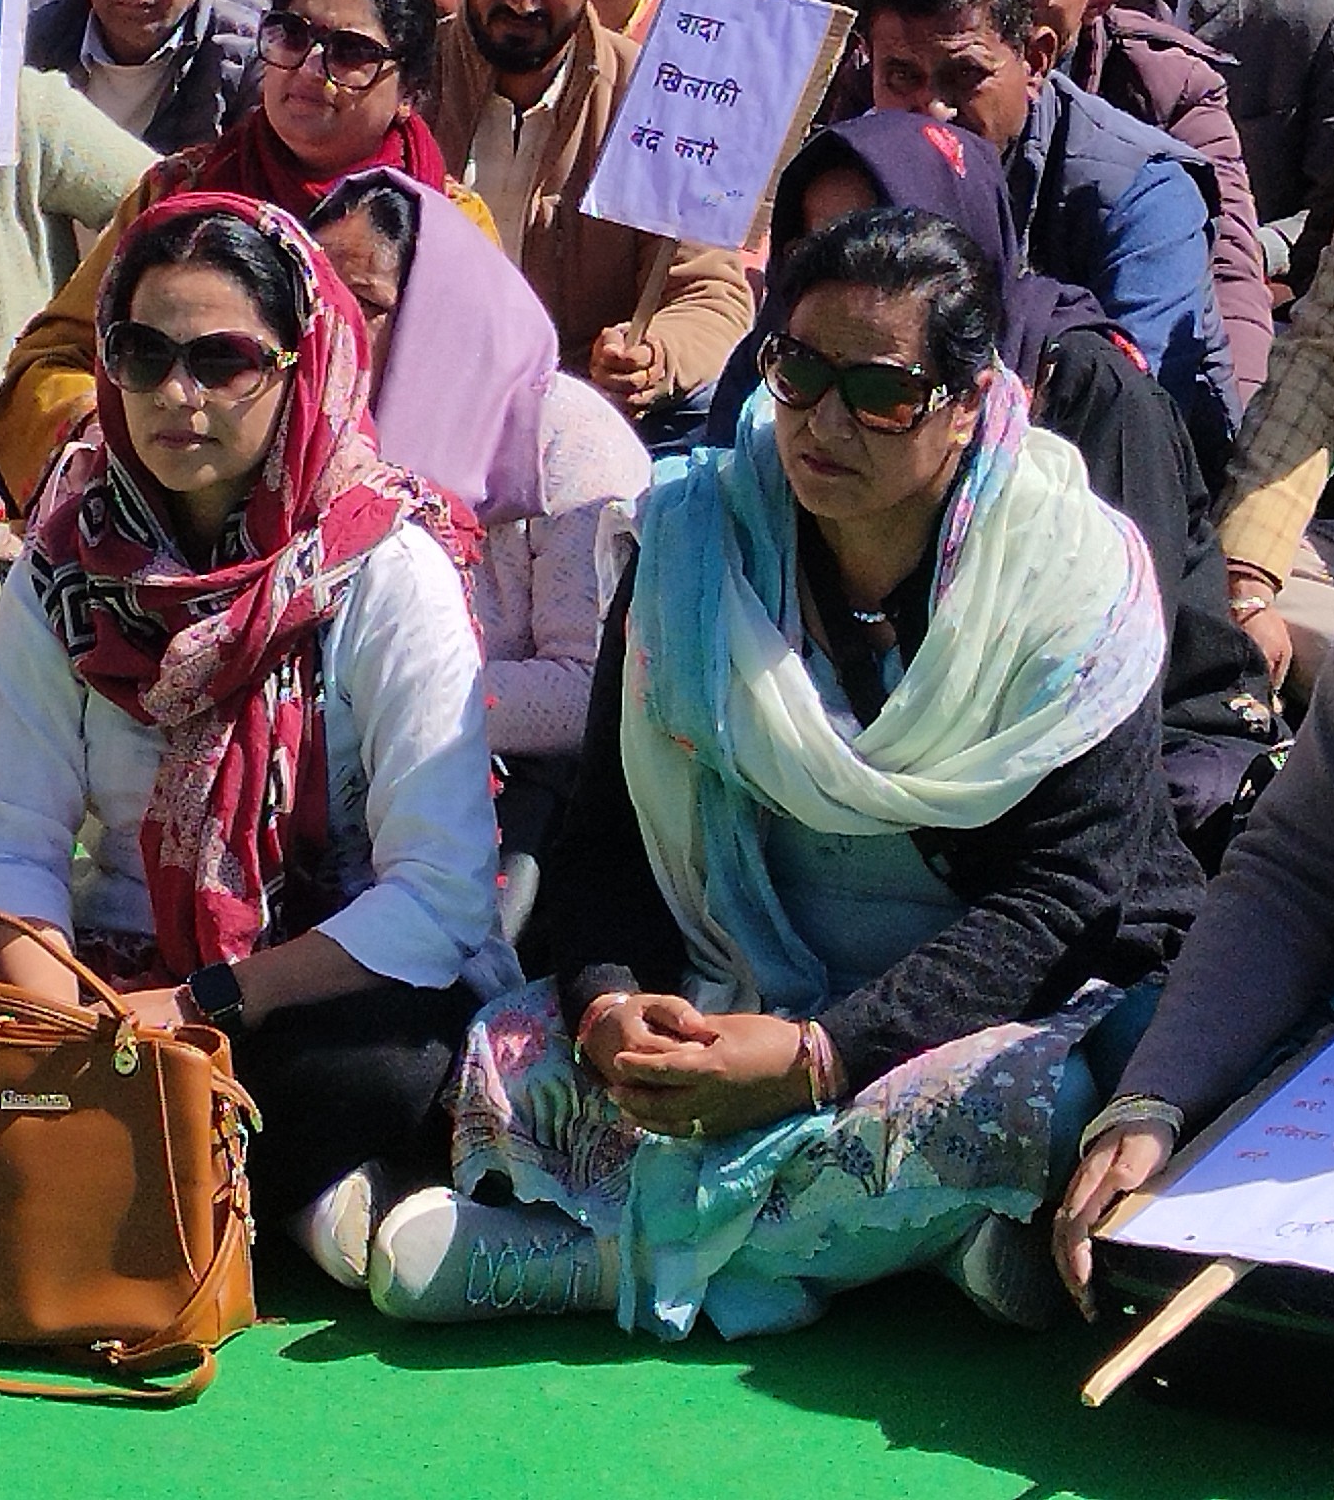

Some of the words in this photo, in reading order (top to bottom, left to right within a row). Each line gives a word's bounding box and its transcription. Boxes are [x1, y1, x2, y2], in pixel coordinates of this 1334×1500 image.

[653, 62, 742, 107] खिलाफी
[630, 117, 666, 153] बंद
[674, 136, 719, 166] करो
